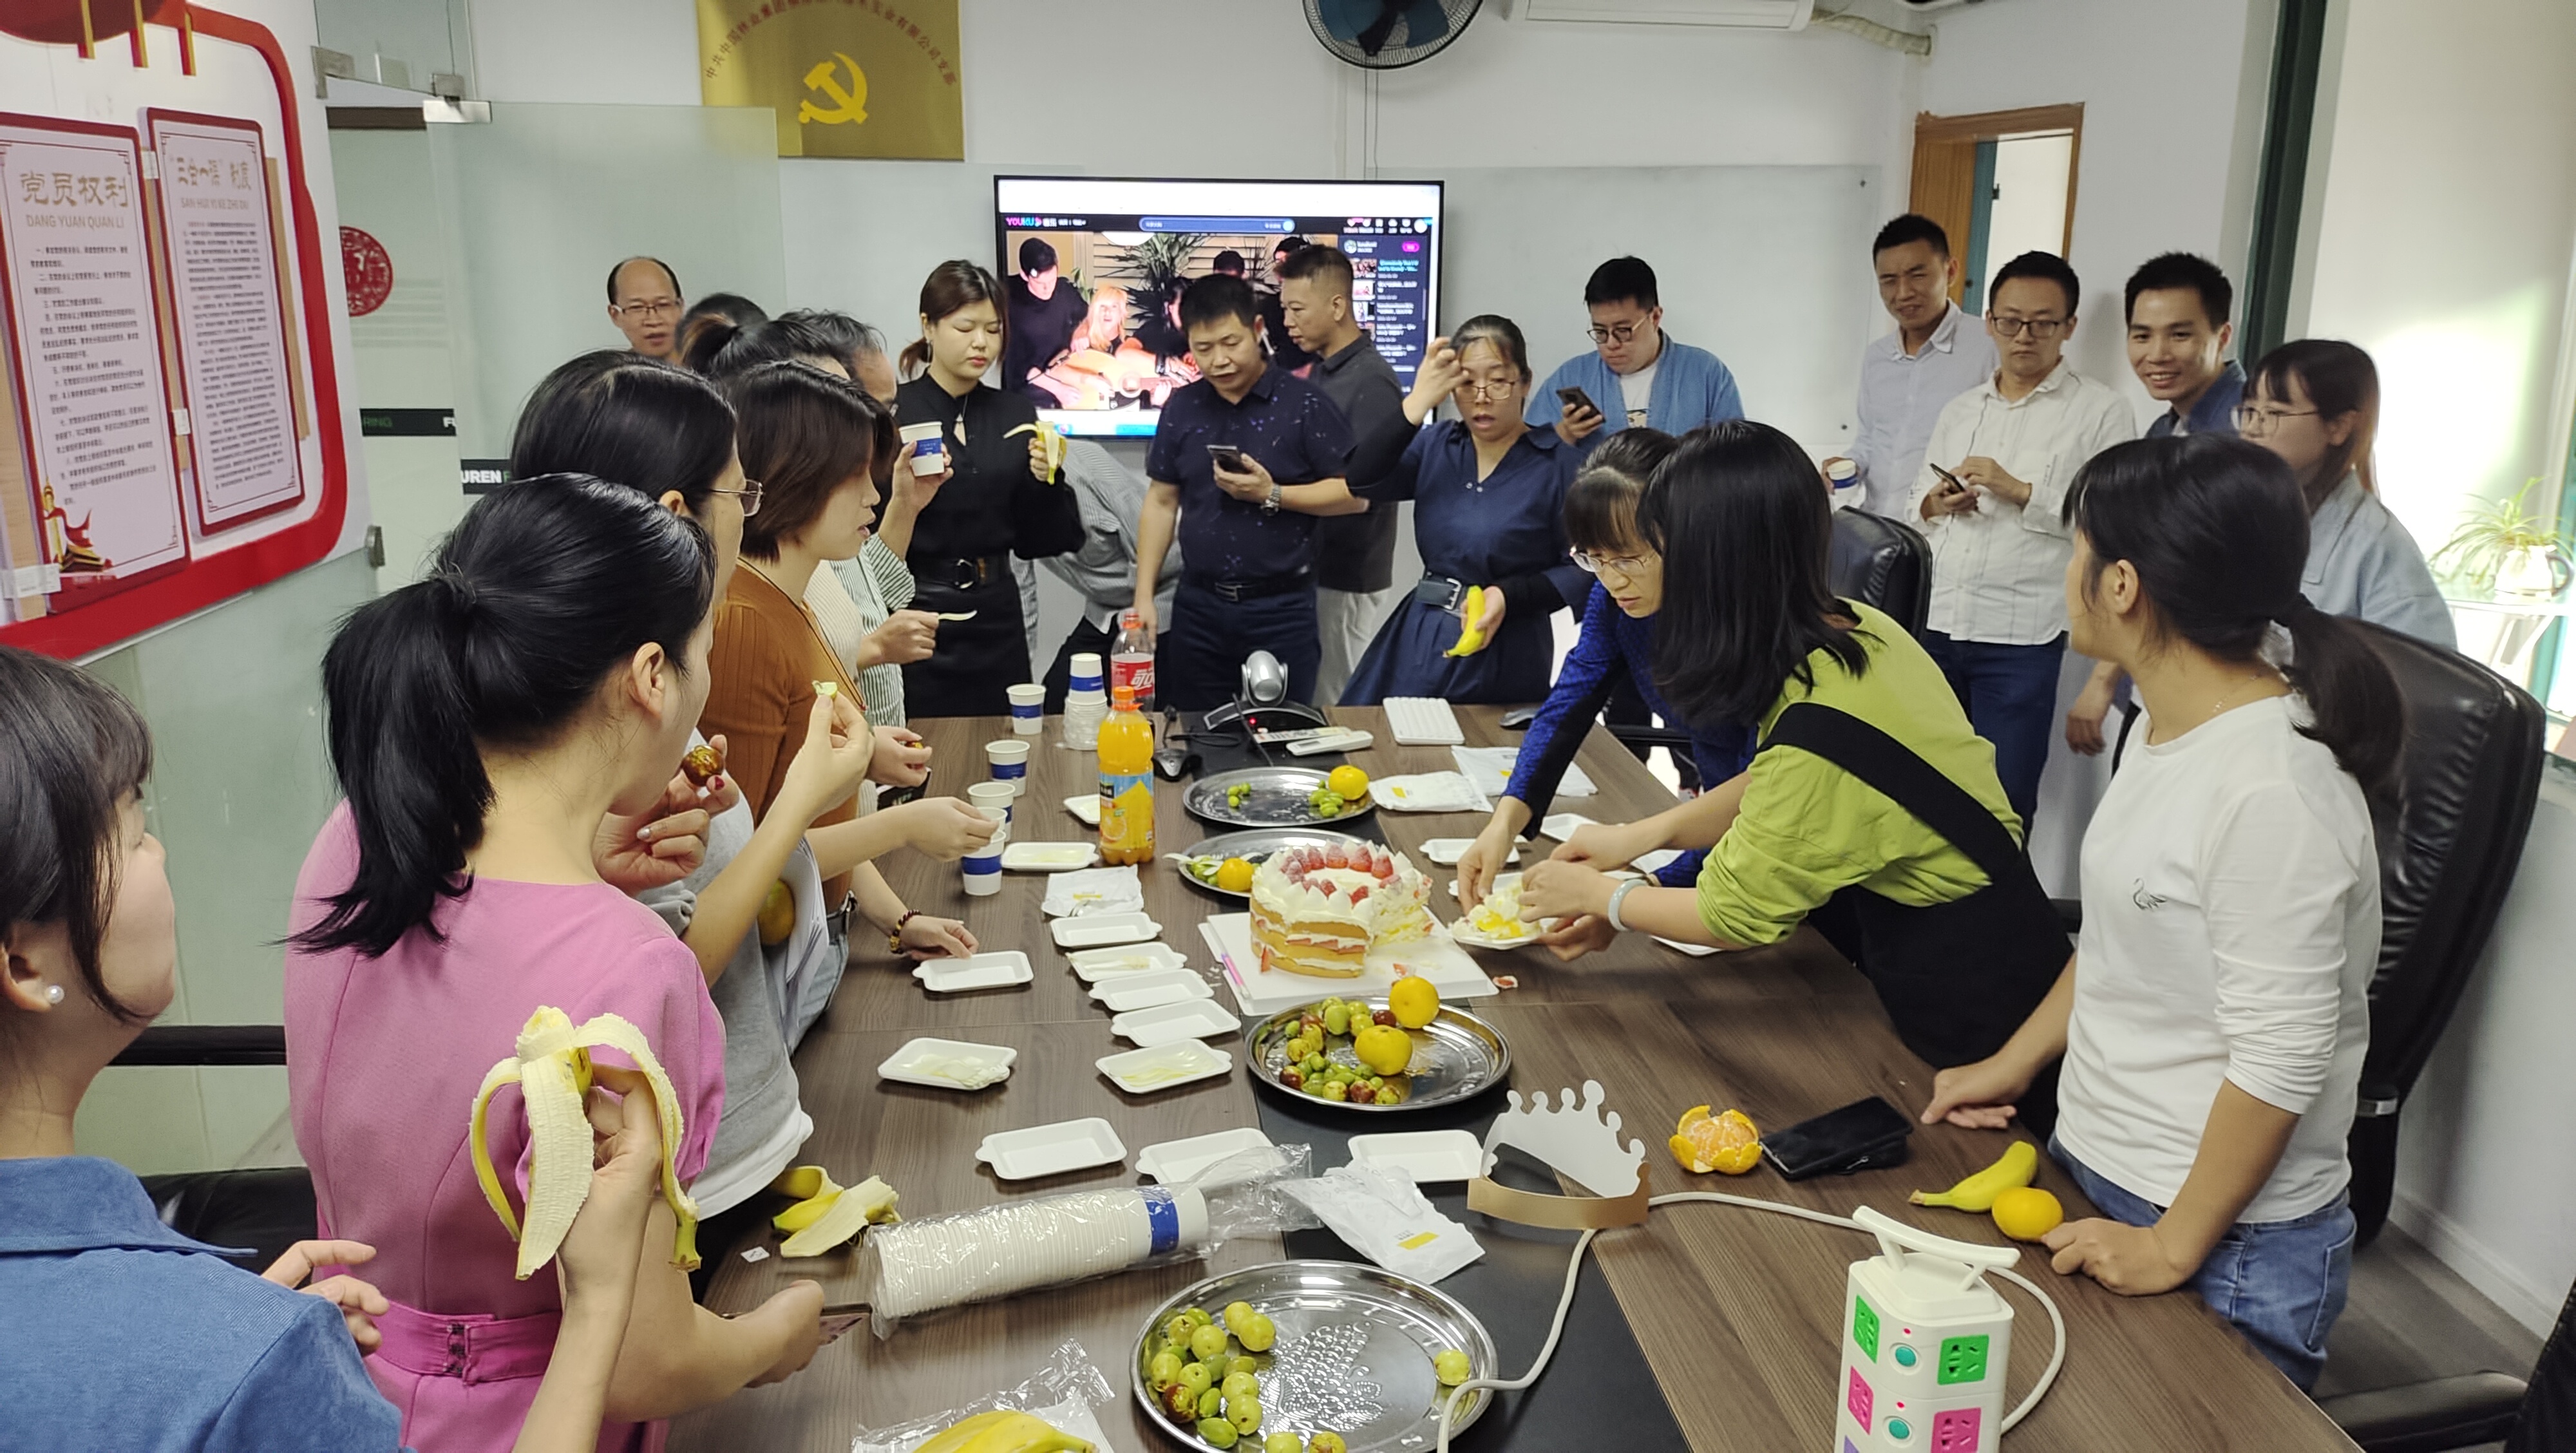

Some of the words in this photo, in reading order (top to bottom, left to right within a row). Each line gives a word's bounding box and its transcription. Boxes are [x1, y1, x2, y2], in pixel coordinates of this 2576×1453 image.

[20, 170, 128, 207] 党员权利
[26, 215, 56, 227] DANG
[59, 216, 86, 227] YUAN
[88, 216, 114, 230] QUAN
[1006, 217, 1034, 226] YOUKU
